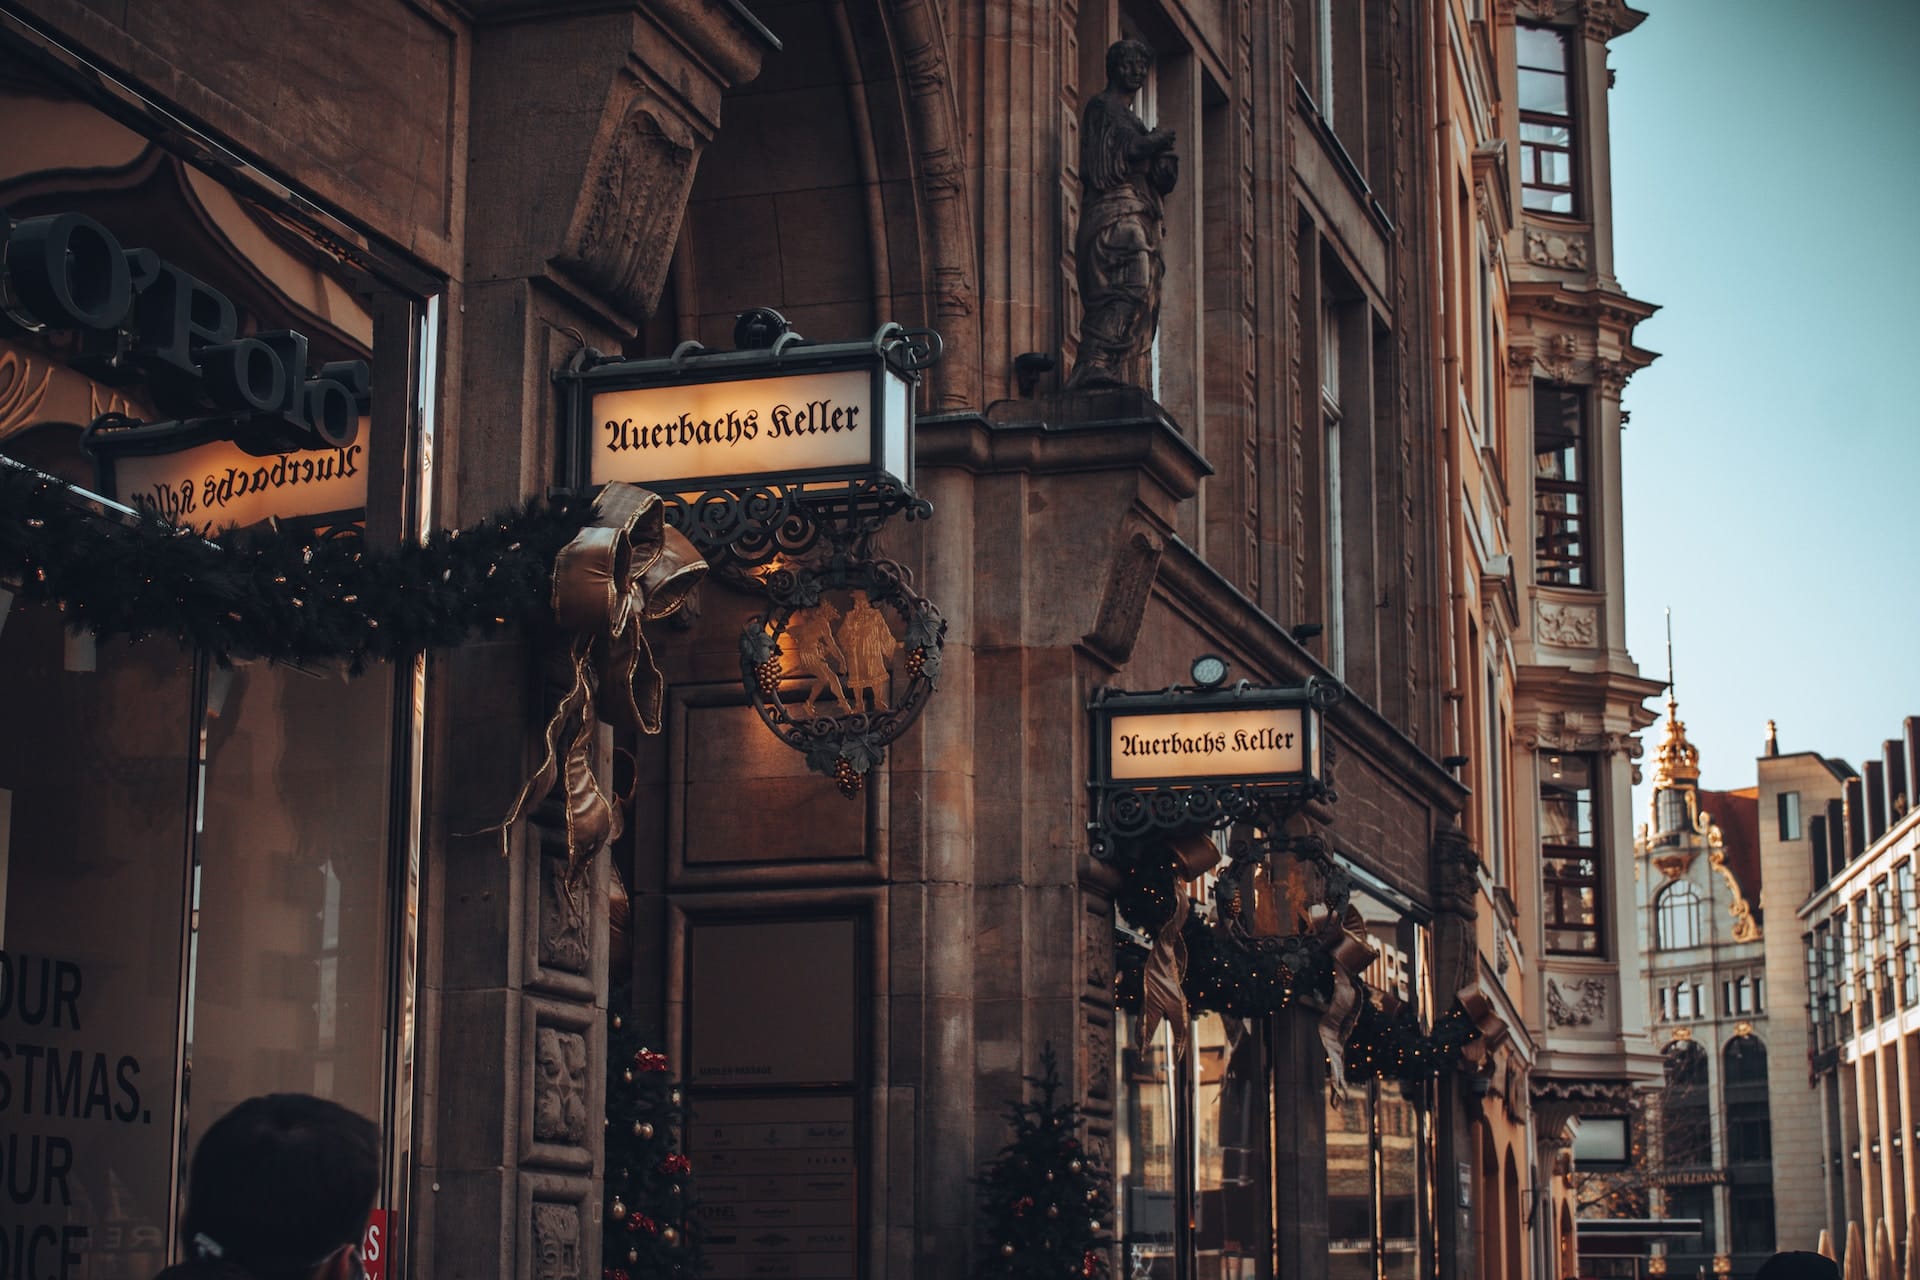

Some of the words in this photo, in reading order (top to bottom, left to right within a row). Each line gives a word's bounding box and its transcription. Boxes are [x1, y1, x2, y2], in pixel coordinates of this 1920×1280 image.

[605, 410, 758, 453] Auerbachs
[767, 399, 859, 439] Keller
[1120, 731, 1226, 757] Auerbachs
[1231, 727, 1294, 753] Keller
[0, 1131, 73, 1206] UR
